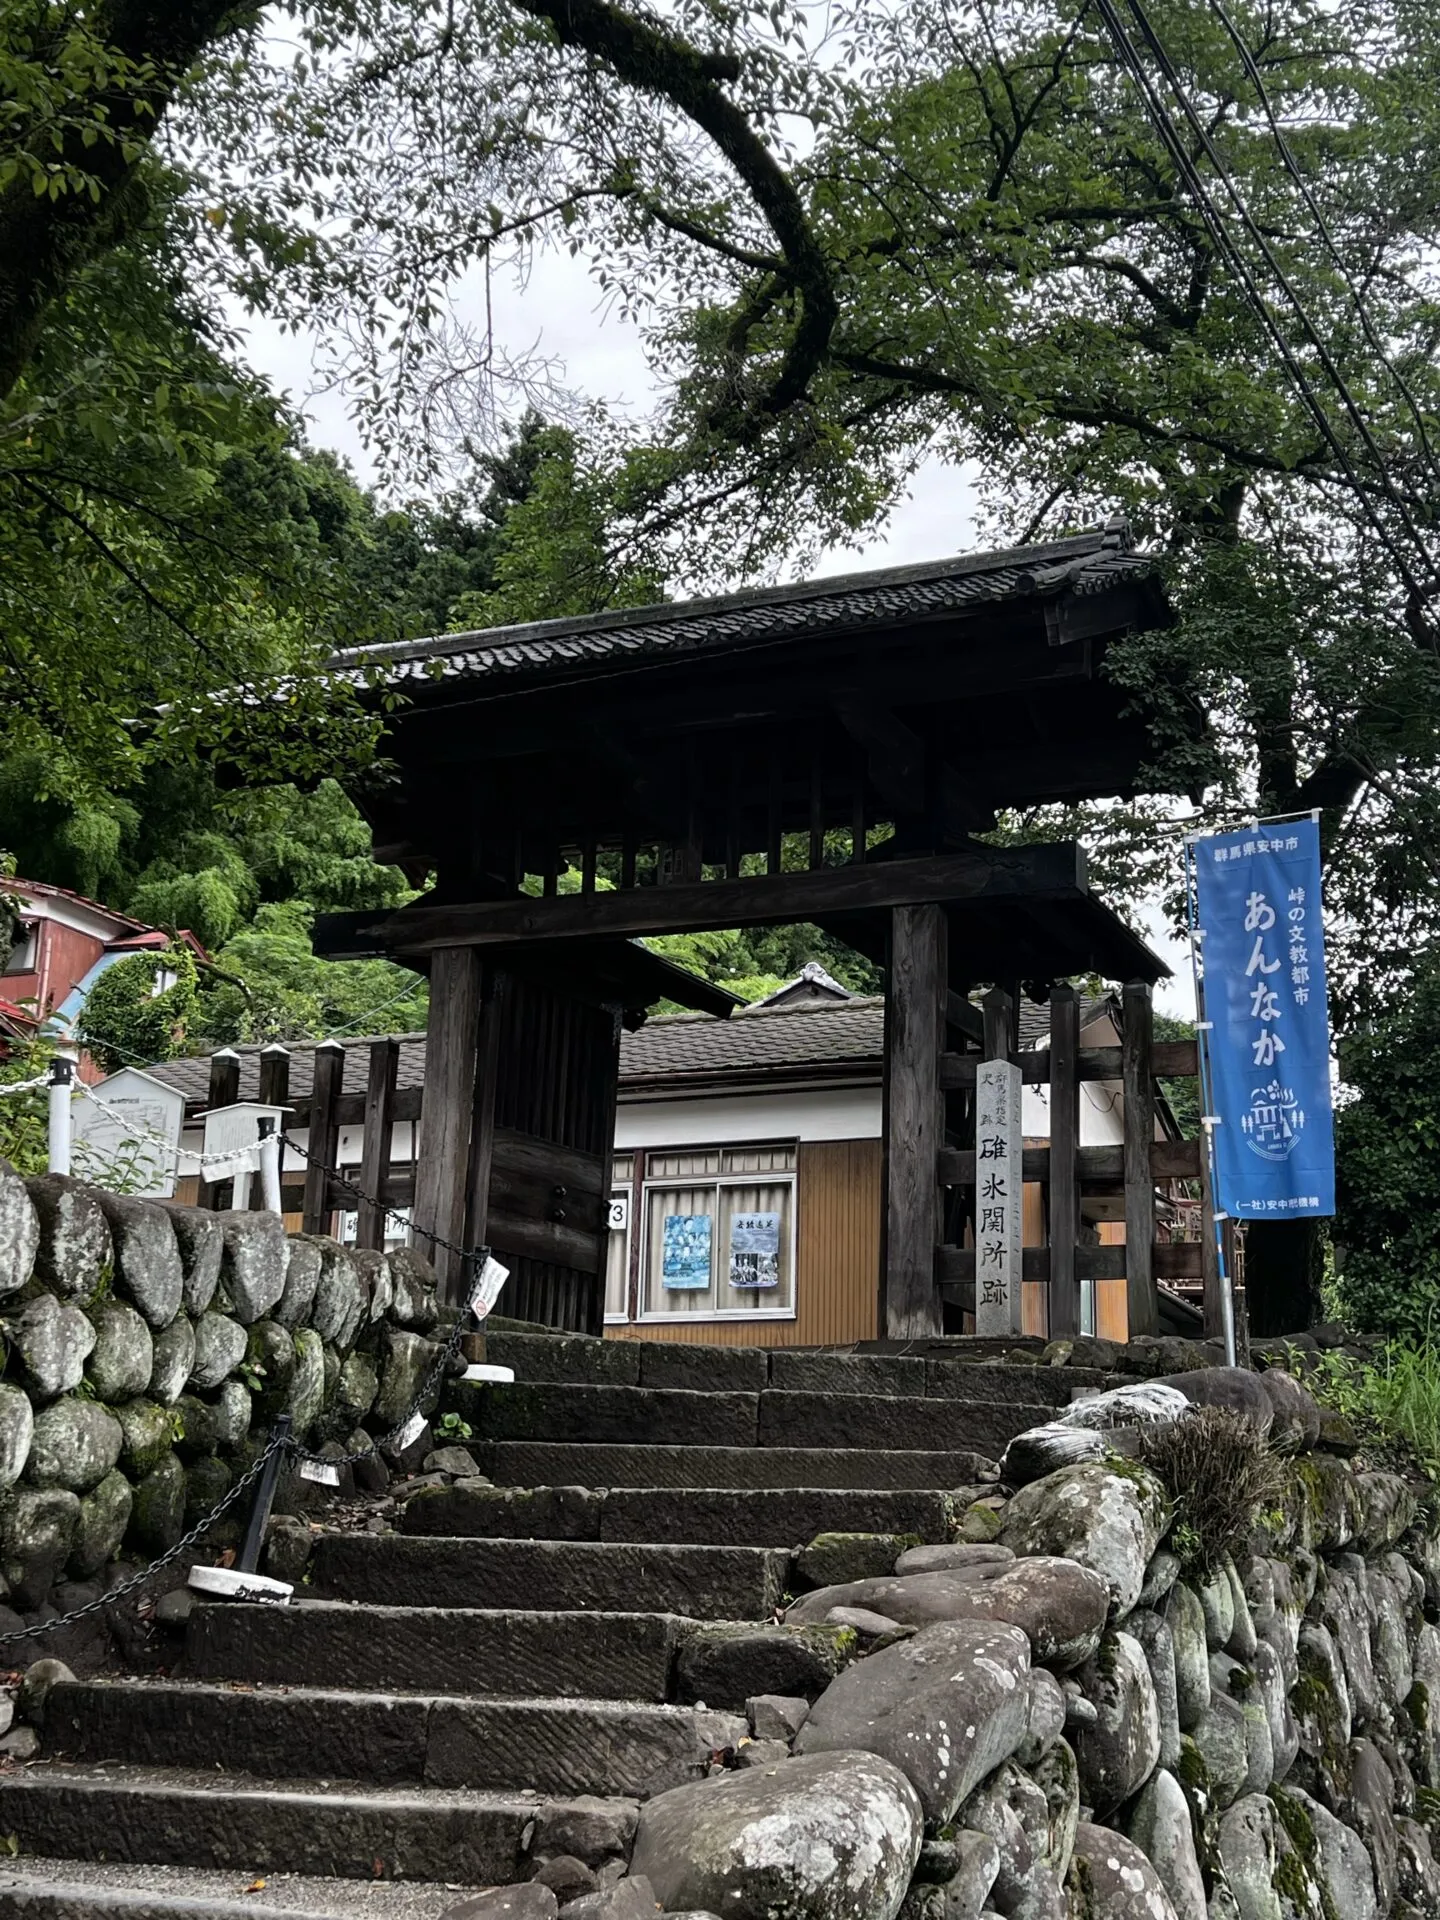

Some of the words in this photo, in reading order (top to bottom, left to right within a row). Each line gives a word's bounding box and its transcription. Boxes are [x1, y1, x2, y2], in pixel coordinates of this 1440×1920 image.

[1214, 837, 1298, 862] 群馬県安中市
[1245, 891, 1286, 1066] あんなか
[1288, 886, 1310, 1006] 峠の文教都市
[612, 1204, 624, 1222] 3
[979, 1134, 1008, 1306] 碓氷関所跡
